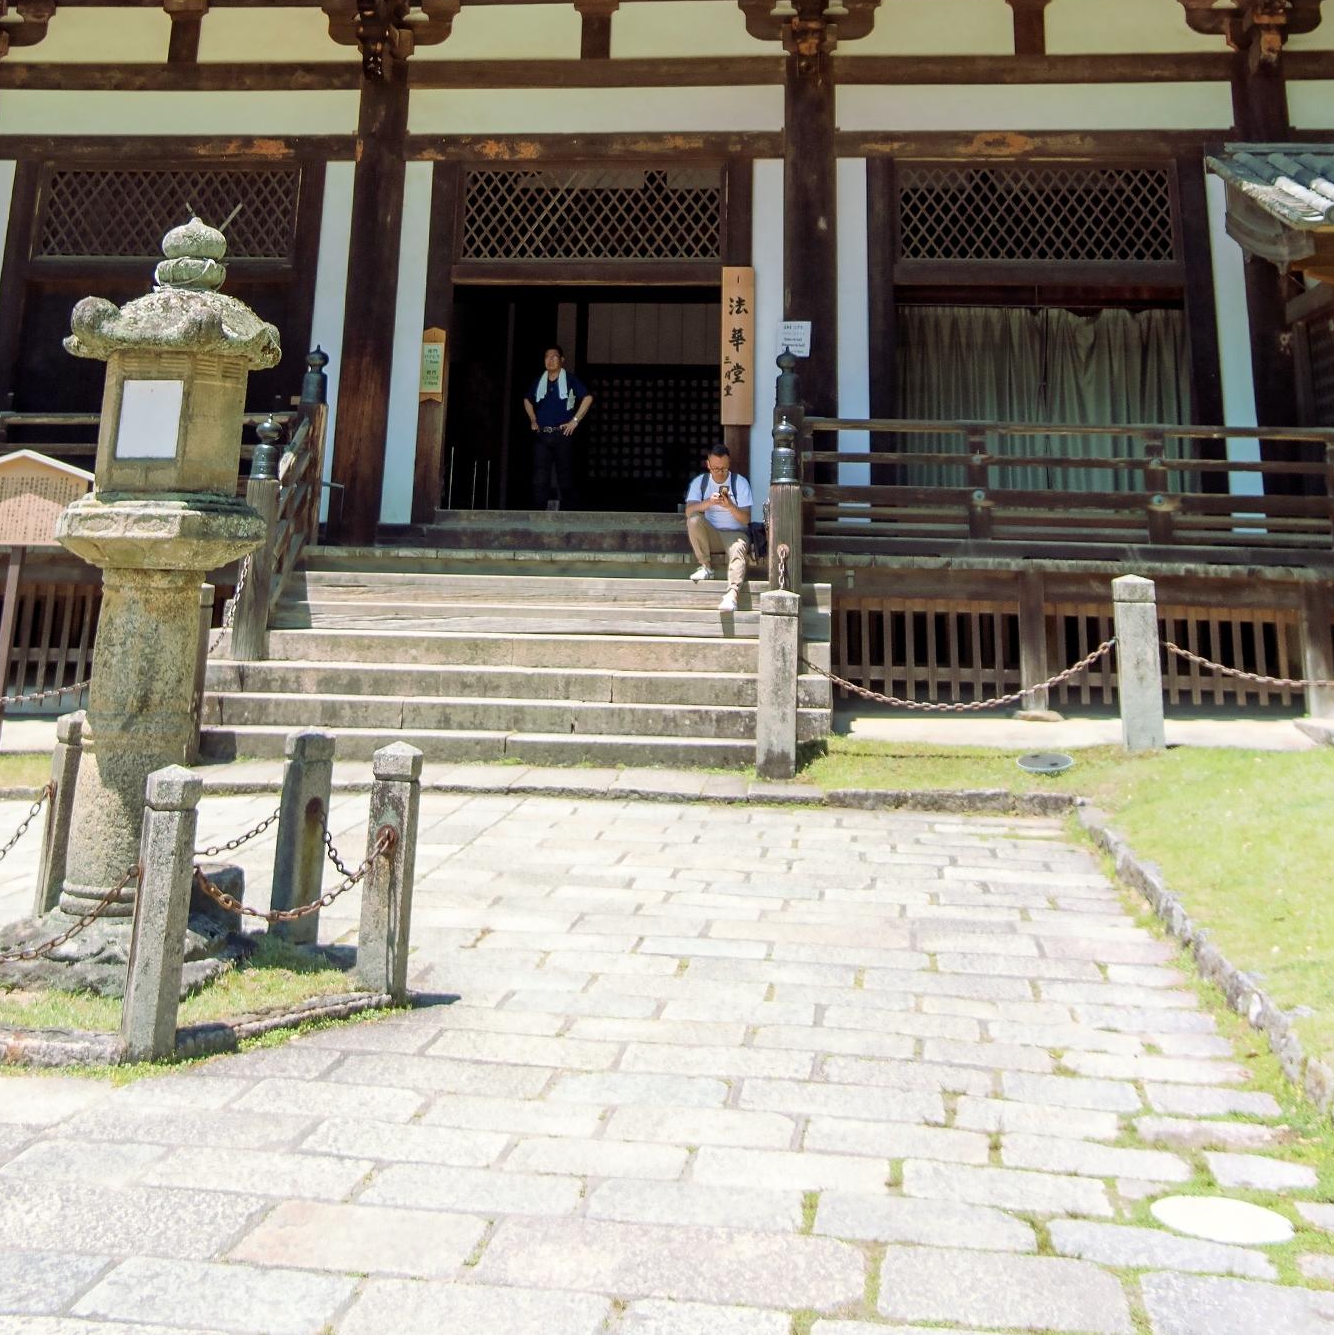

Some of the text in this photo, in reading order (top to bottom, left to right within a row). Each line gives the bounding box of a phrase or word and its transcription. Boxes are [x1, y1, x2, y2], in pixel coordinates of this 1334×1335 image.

[728, 296, 748, 384] 法華堂
[723, 355, 733, 397] 三月堂
